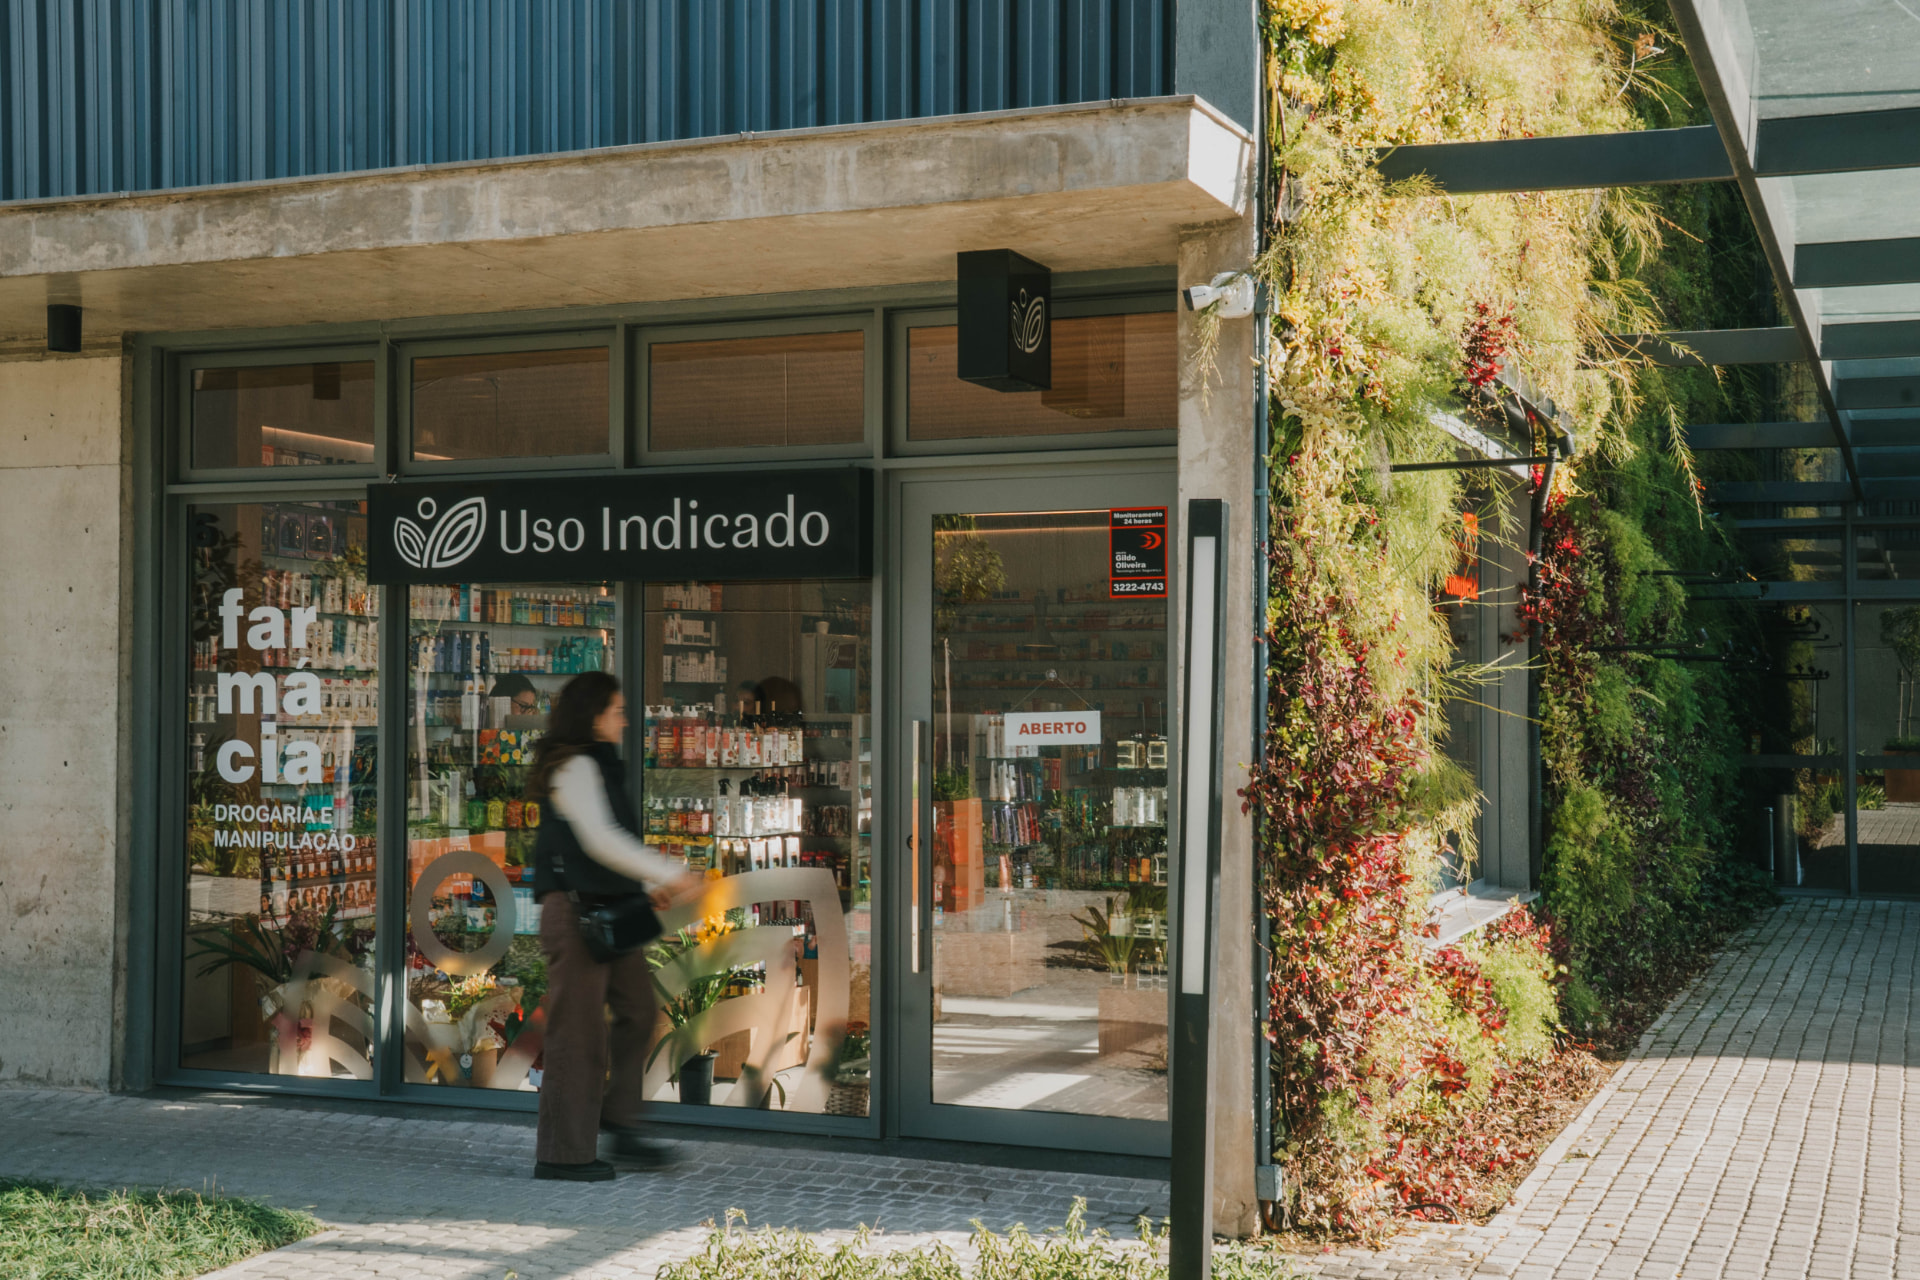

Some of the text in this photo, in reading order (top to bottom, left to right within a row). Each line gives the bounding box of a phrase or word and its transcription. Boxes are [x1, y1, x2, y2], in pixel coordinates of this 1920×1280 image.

[500, 493, 830, 554] Uso Indicado
[1115, 561, 1146, 569] Oliveira
[1113, 582, 1164, 592] 3222-4743
[218, 587, 317, 651] far
[217, 656, 322, 716] má
[1019, 721, 1087, 735] ABERTO
[216, 721, 323, 785] cia
[214, 804, 333, 824] DROGARIA E
[213, 828, 356, 855] MANIPULAÇÃO
